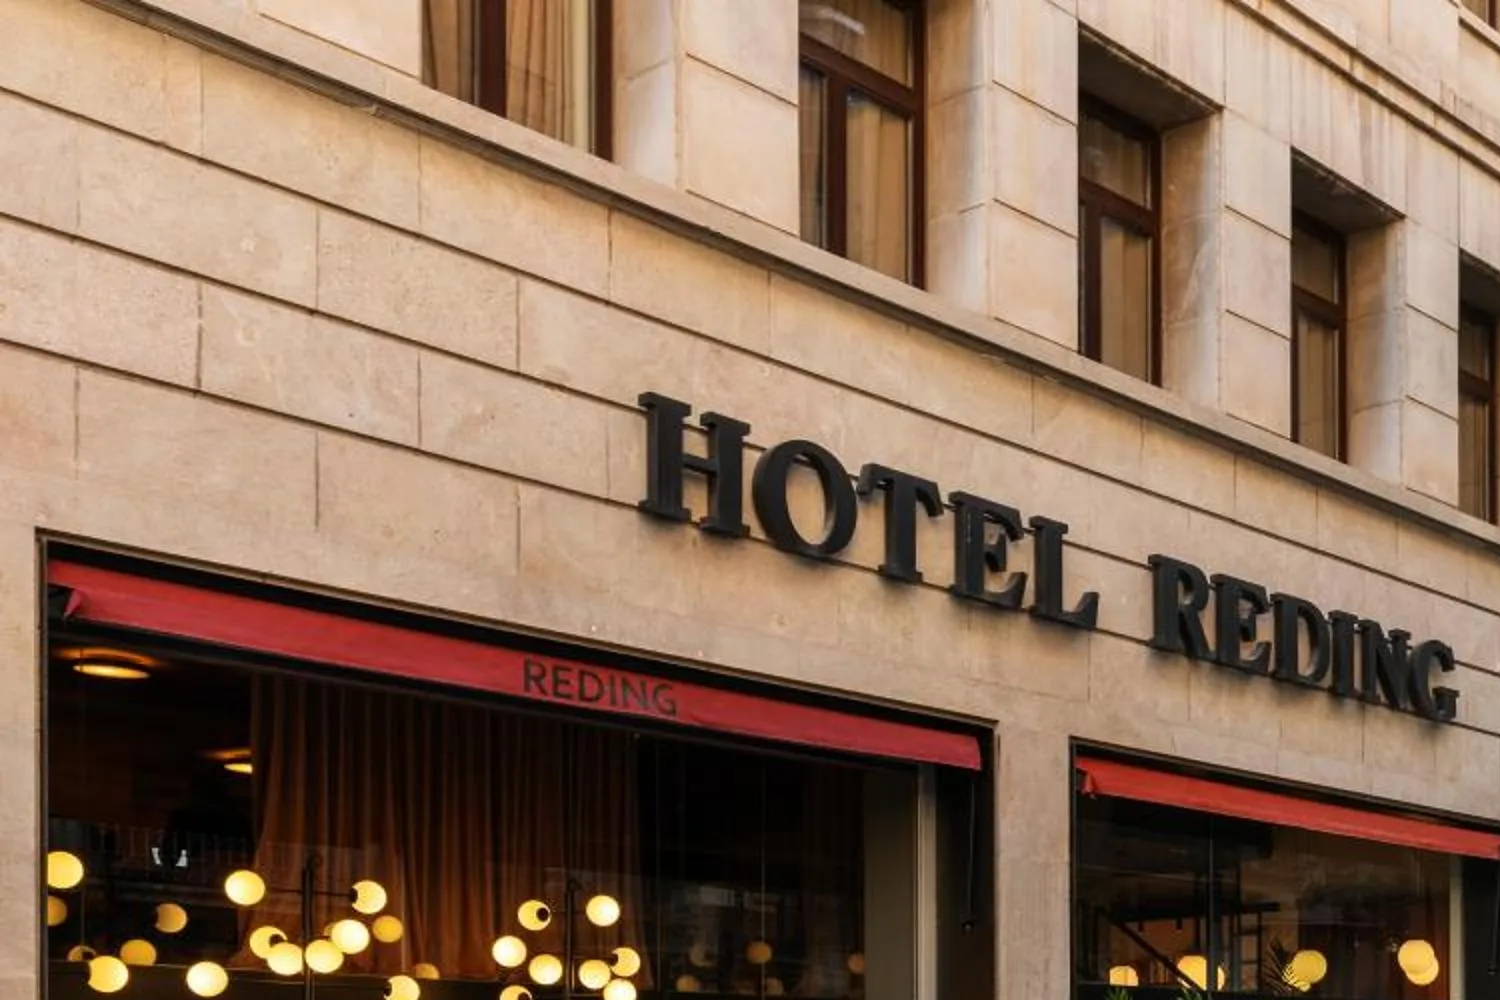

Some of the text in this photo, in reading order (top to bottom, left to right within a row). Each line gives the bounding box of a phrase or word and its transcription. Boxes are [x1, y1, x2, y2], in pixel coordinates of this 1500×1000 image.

[638, 391, 1459, 722] HOTEL REDING
[523, 657, 677, 716] REDING
